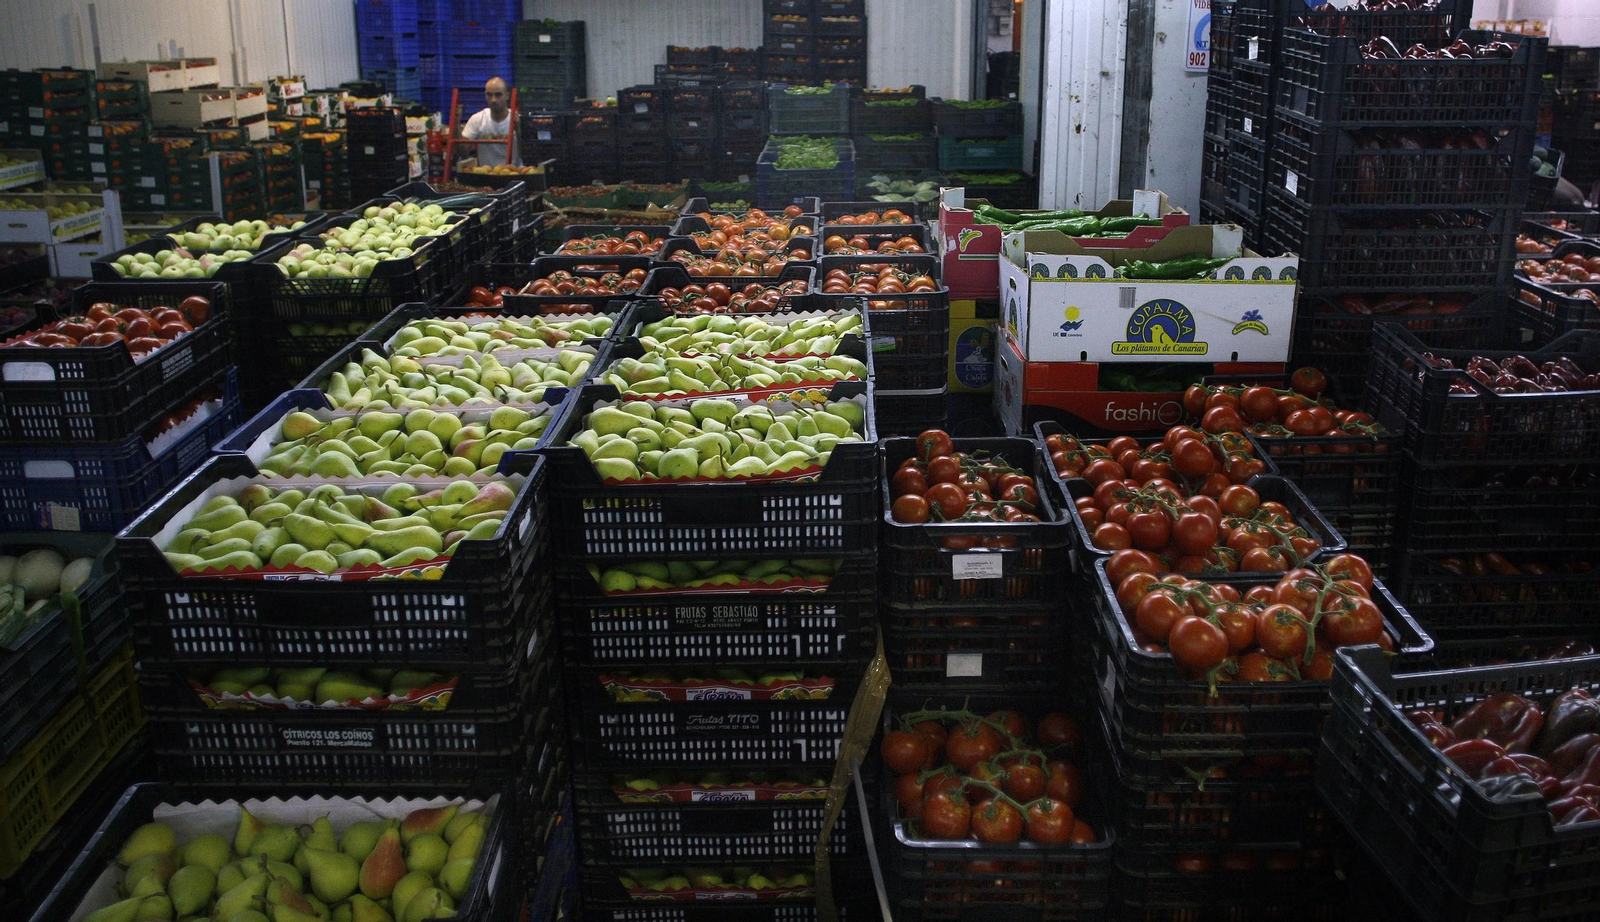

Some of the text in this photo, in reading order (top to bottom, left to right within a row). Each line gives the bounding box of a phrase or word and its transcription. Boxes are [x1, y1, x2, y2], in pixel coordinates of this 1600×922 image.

[1190, 52, 1206, 67] 902
[1129, 302, 1193, 336] COPALMA
[1116, 343, 1205, 354] Los plátanos de Canarias
[675, 607, 706, 619] FRUTAS
[687, 714, 759, 725] Frutas TITO
[282, 728, 323, 739] CÍTRICOS
[324, 730, 341, 740] LOS
